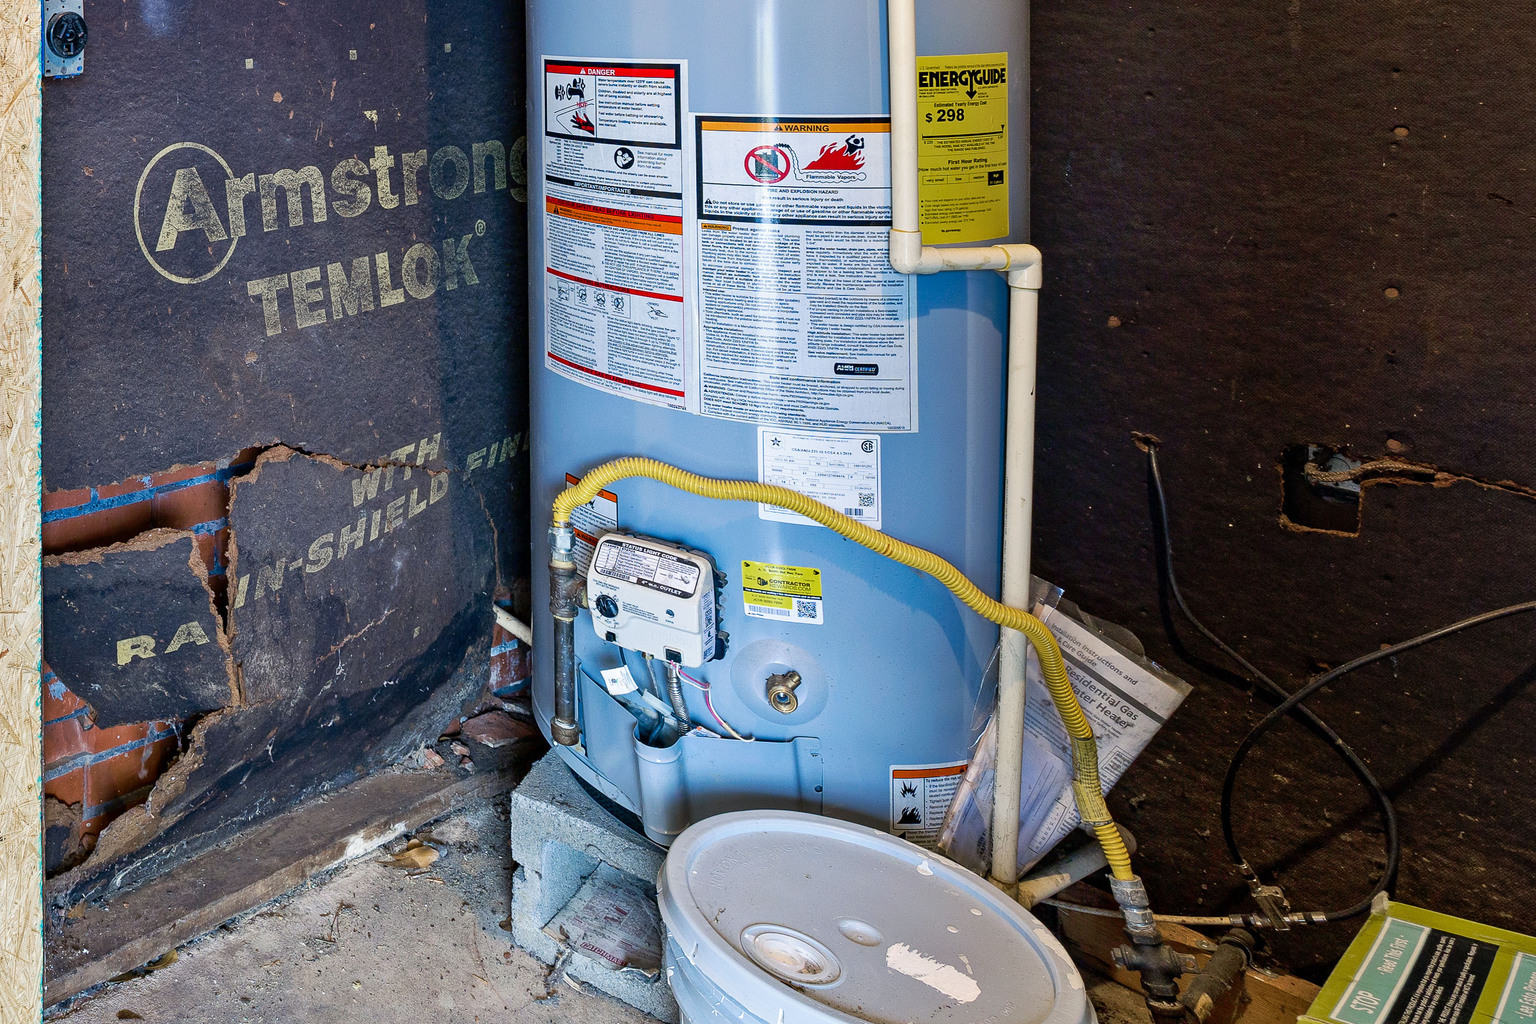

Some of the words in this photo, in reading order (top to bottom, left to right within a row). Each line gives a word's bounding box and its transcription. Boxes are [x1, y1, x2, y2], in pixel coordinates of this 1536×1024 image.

[919, 68, 1006, 87] ENERGYGUIDE
[937, 109, 964, 122] 298
[351, 432, 443, 507] WITH
[622, 543, 643, 552] STATUS
[662, 553, 678, 561] CODE
[660, 586, 682, 595] OUTLET
[769, 579, 811, 587] CONTRACTOR
[1051, 623, 1081, 647] Installation
[1082, 645, 1123, 676] Instructions
[1123, 674, 1138, 686] and
[1062, 640, 1076, 653] Care
[1076, 649, 1097, 667] Guide
[1065, 666, 1120, 707] Residential
[1120, 706, 1139, 721] Gas
[1096, 702, 1130, 729] Heater
[1390, 937, 1409, 951] First
[1384, 949, 1403, 960] This
[1377, 958, 1398, 974] Read
[1350, 990, 1381, 1014] STOP
